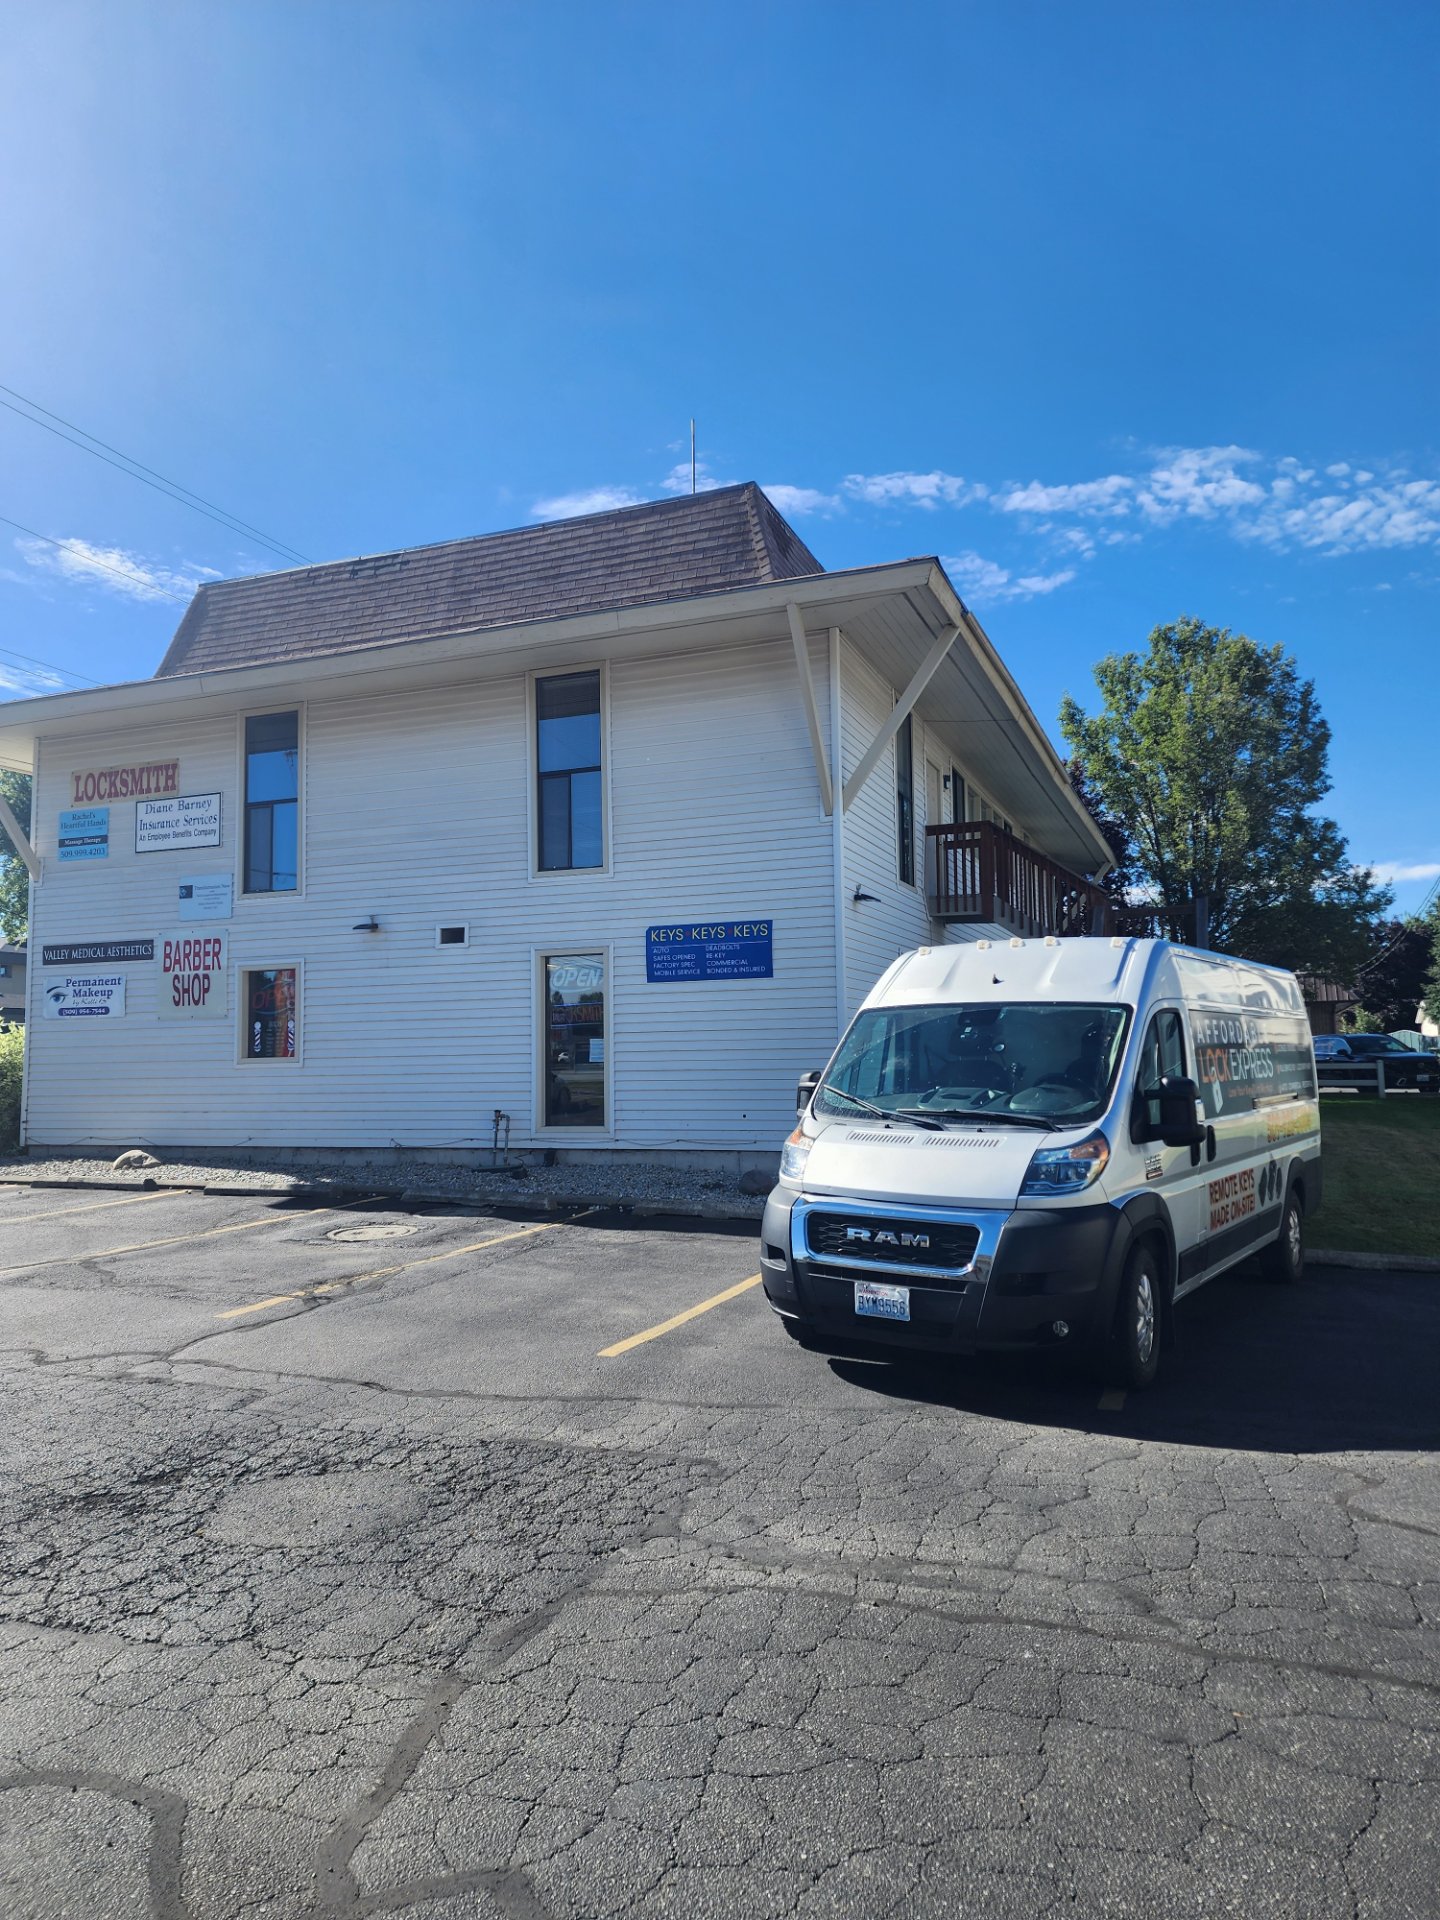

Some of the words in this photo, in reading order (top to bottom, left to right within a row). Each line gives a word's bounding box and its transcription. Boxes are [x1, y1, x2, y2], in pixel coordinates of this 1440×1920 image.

[74, 763, 178, 802] LOCKSMITH
[145, 803, 173, 815] Diane
[178, 799, 212, 812] Barney
[139, 819, 180, 831] Insurance
[183, 814, 218, 828] Services
[139, 834, 147, 842] An
[147, 832, 171, 841] Employee
[172, 830, 192, 839] Benefits
[193, 828, 217, 837] Company
[651, 929, 684, 942] KEYS
[692, 926, 726, 940] KEYS
[733, 923, 768, 937] KEYS
[44, 949, 69, 961] VALLEY
[71, 947, 105, 959] MEDICAL
[107, 944, 152, 957] AESTHETICS
[163, 938, 222, 973] BARBER
[706, 959, 748, 967] COMMERCIAL
[65, 977, 122, 988] Permanent
[553, 968, 601, 987] OPEN
[72, 987, 113, 1000] Makeup
[172, 973, 211, 1007] SHOP
[1209, 1175, 1239, 1206] REMOTE
[1239, 1168, 1255, 1192] KEYS
[1210, 1201, 1230, 1231] MADE
[847, 1227, 929, 1248] RAM
